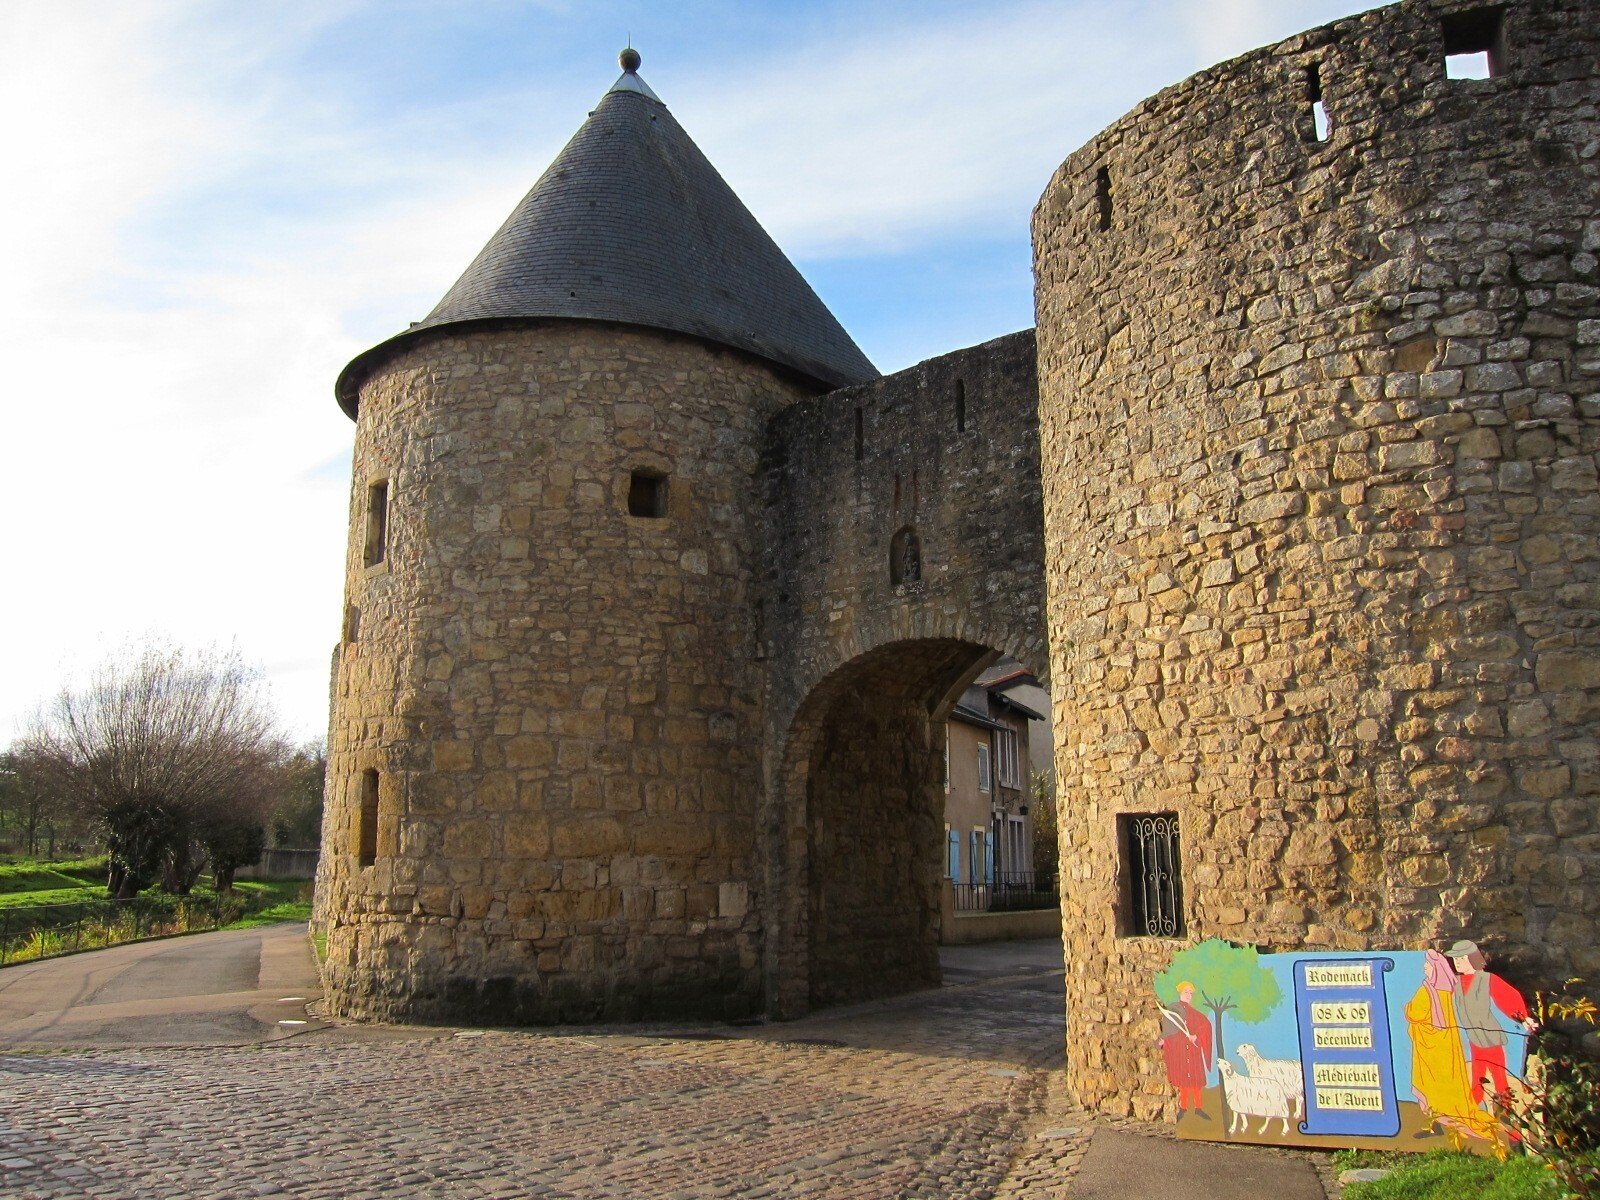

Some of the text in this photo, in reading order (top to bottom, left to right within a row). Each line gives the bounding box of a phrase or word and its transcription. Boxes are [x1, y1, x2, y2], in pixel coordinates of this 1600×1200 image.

[1309, 970, 1369, 983] Rodemack
[1317, 1006, 1367, 1020] 08 & 09
[1316, 1032, 1369, 1045] décembre
[1316, 1068, 1377, 1083] Médiévale
[1318, 1092, 1380, 1106] de l'Avent
